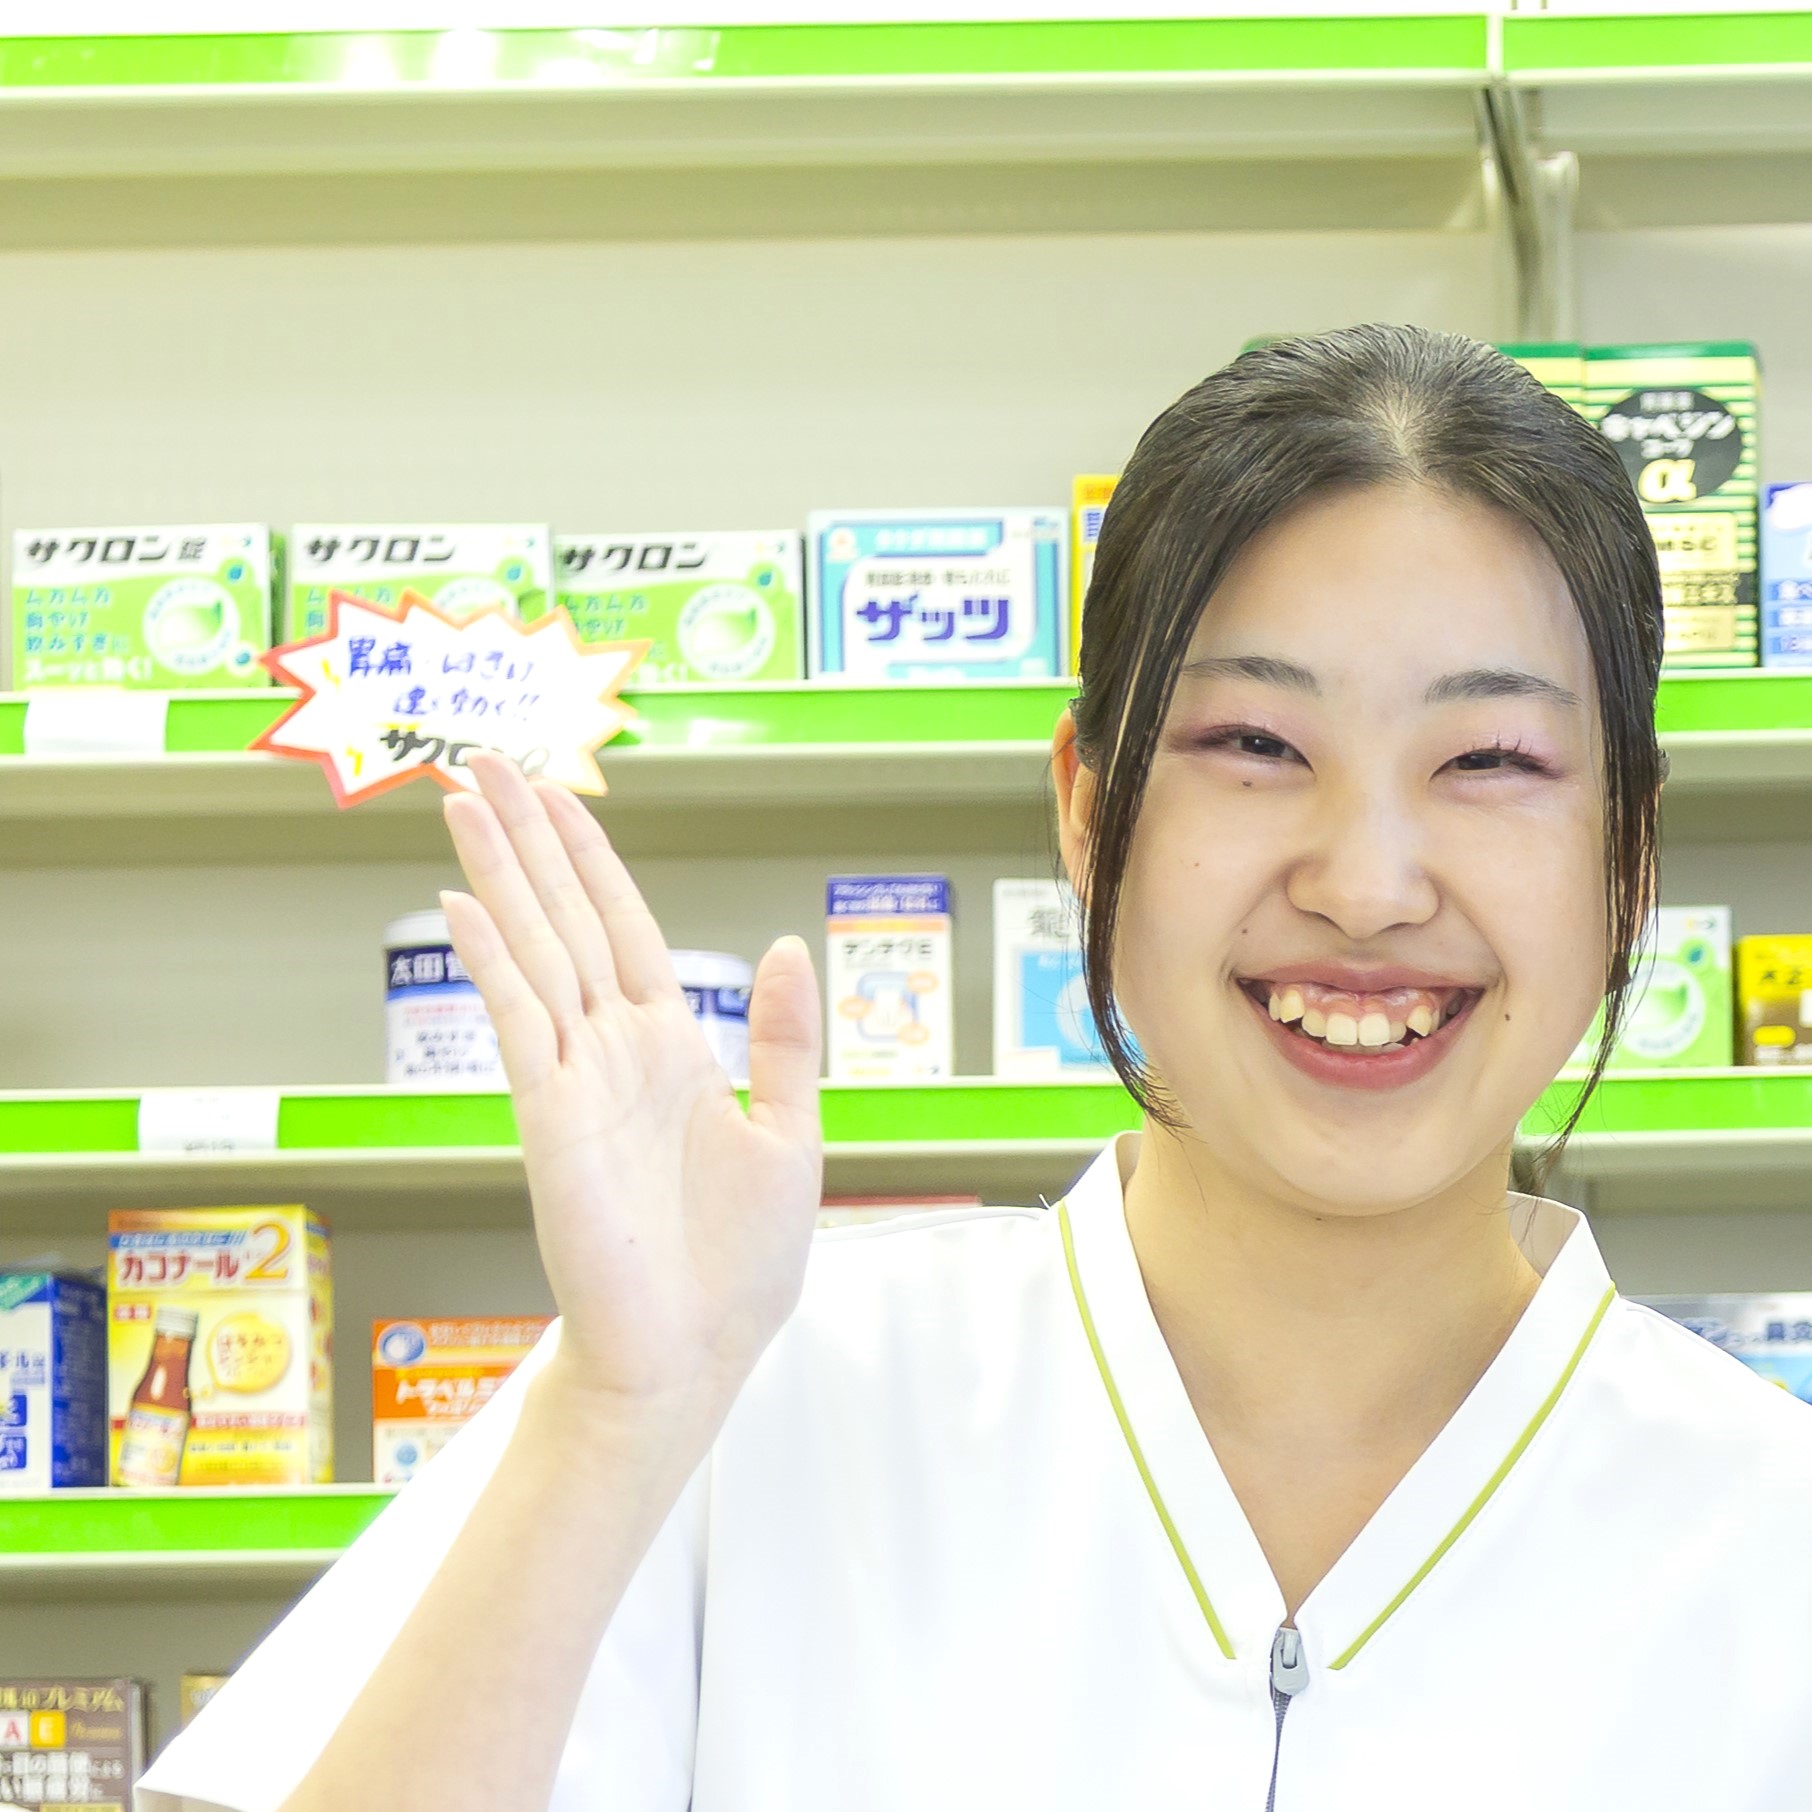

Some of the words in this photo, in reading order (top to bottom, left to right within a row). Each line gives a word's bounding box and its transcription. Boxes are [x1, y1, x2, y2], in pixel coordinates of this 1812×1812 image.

[1638, 458, 1698, 503] α
[27, 535, 206, 563] サクロン錠
[307, 535, 456, 563] サクロン
[559, 541, 708, 570] サクロン
[856, 590, 1010, 641] ザッツ
[378, 728, 505, 767] サクロ
[122, 1252, 239, 1282] カコナール
[245, 1223, 291, 1280] 2
